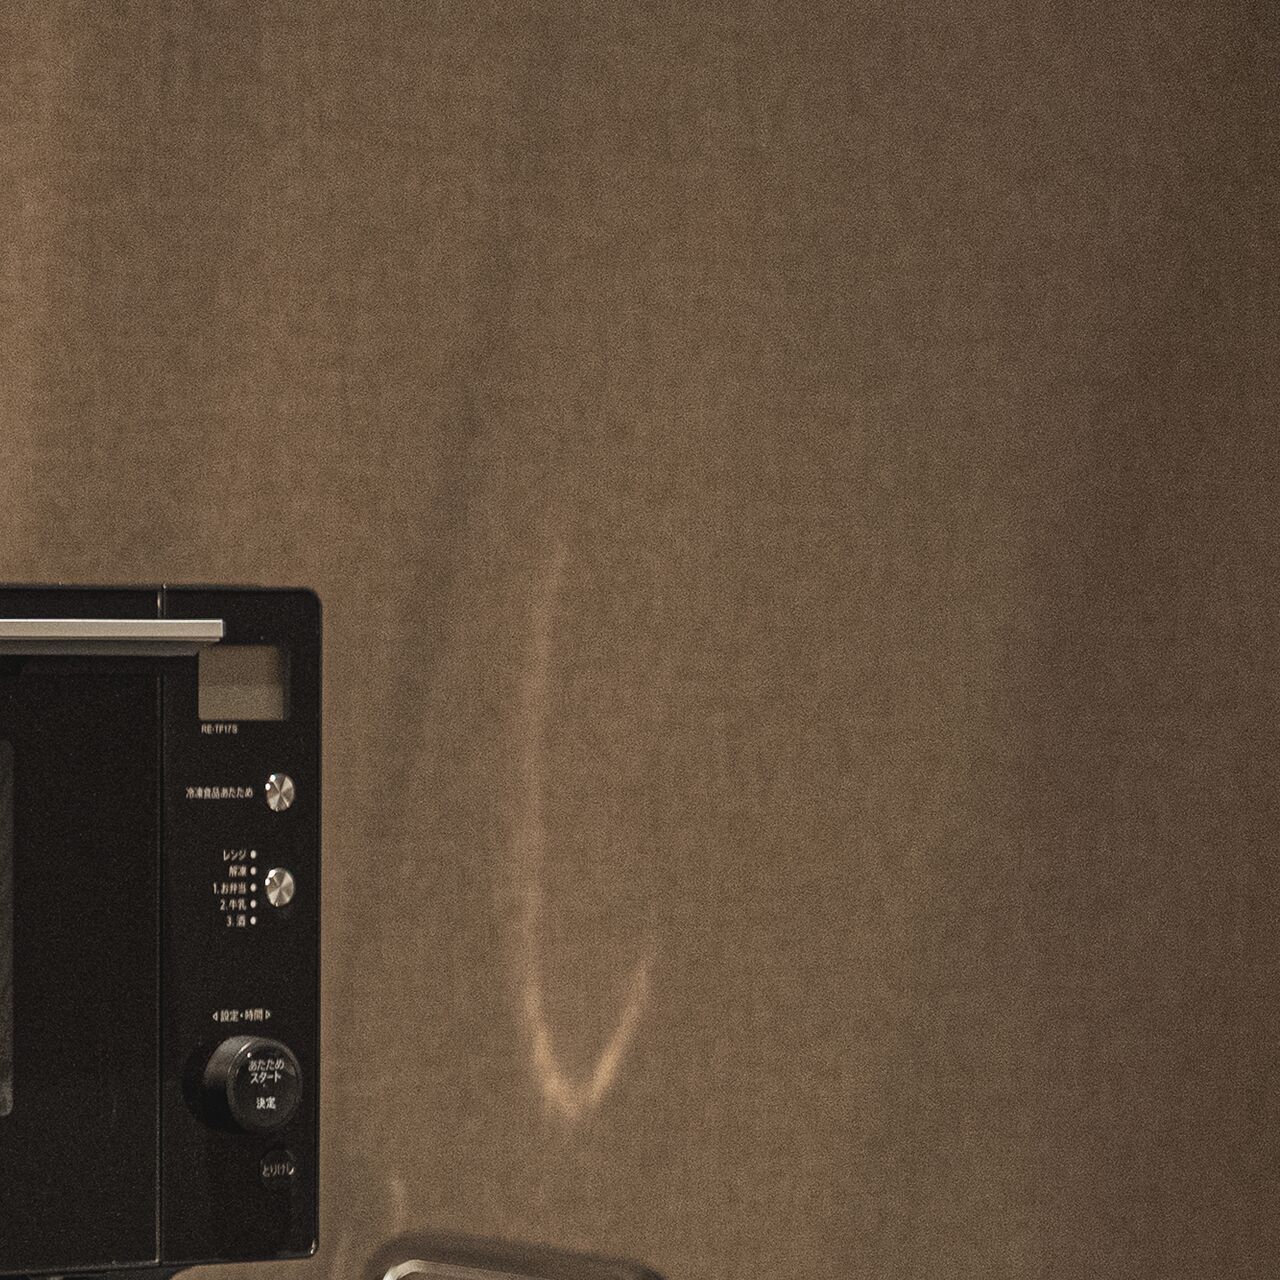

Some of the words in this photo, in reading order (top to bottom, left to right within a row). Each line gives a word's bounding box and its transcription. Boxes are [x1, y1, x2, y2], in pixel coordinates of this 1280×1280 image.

[185, 786, 254, 799] 冷凍食品あたため
[223, 849, 247, 861] レンジ
[228, 865, 247, 877] 解凍
[248, 1058, 285, 1071] あたため
[250, 1071, 282, 1084] スタート
[256, 1096, 276, 1110] 決定
